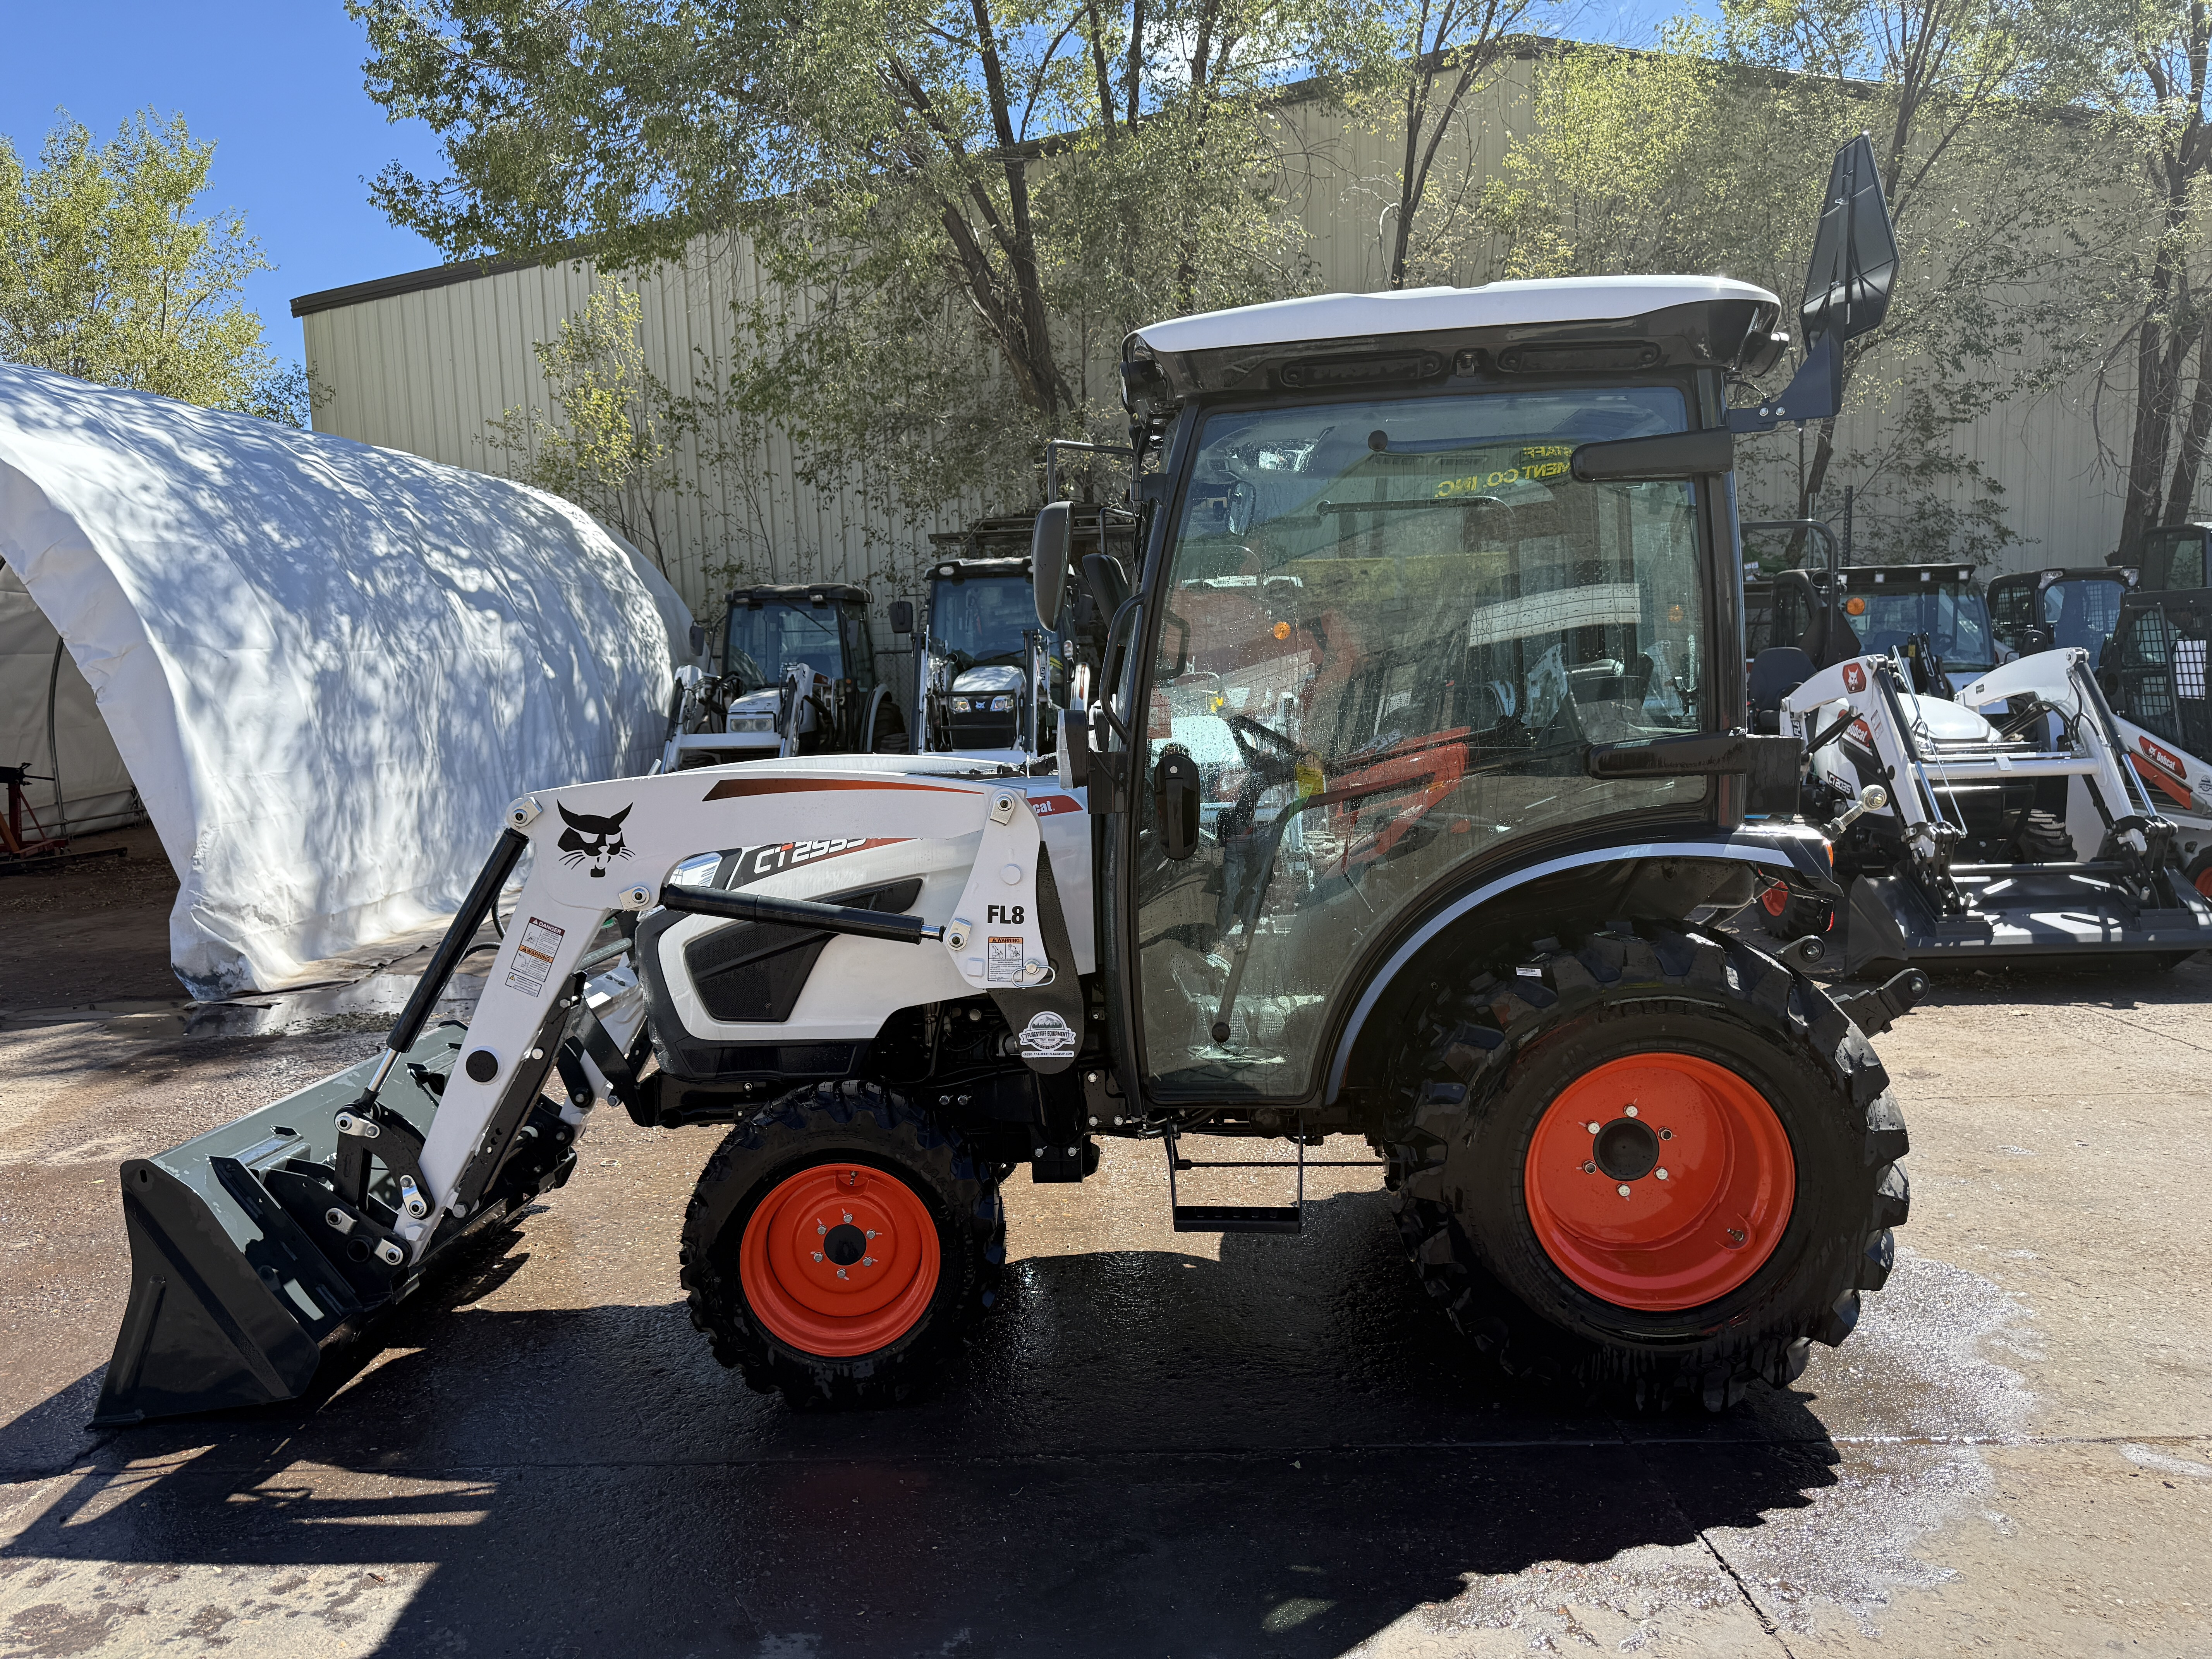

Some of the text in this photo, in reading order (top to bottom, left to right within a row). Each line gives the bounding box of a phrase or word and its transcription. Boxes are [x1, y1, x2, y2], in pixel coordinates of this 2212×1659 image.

[2156, 752, 2176, 771] Bobcat
[1829, 774, 1851, 794] CT2035
[1032, 800, 1053, 814] cat
[987, 905, 1024, 924] FL8
[539, 921, 562, 934] DANGER
[527, 949, 550, 961] WARNING
